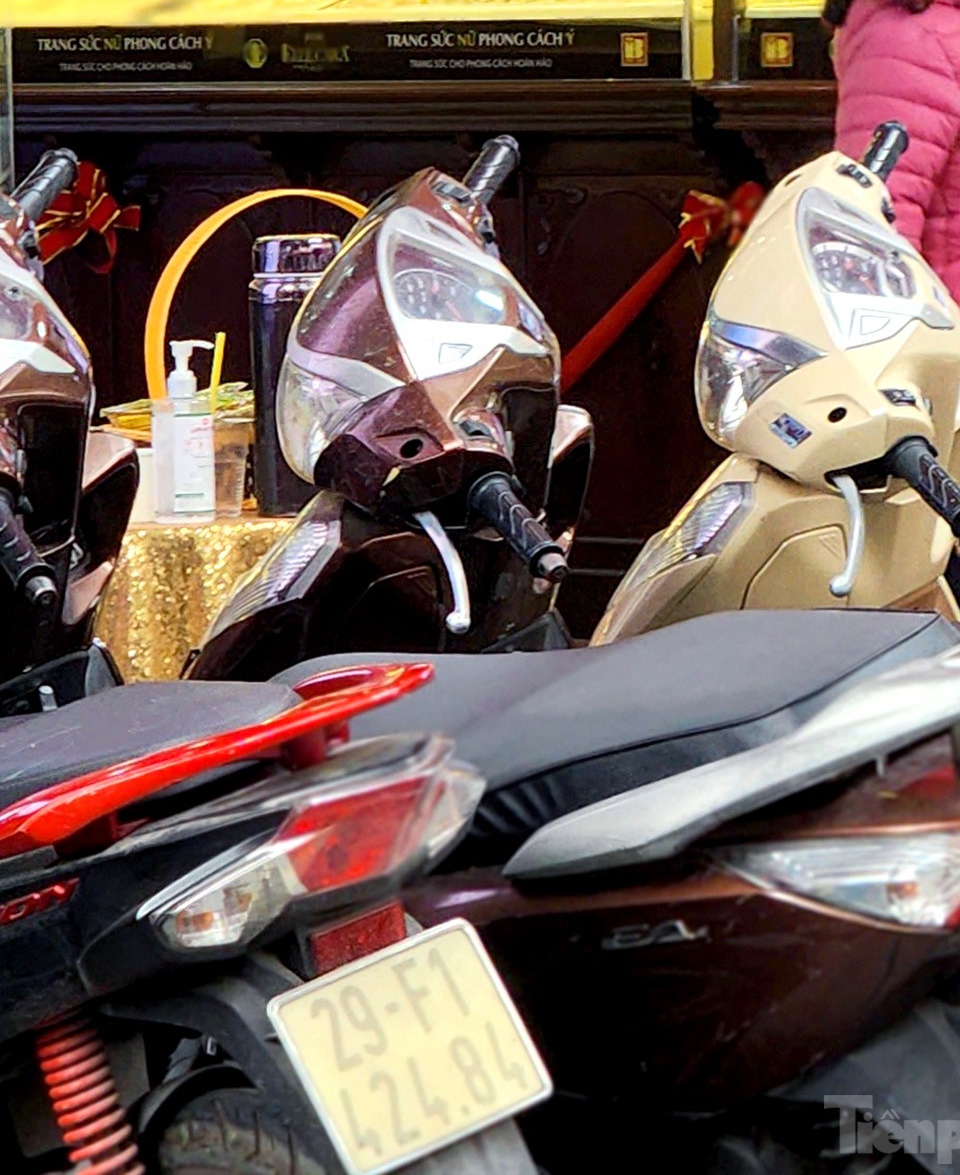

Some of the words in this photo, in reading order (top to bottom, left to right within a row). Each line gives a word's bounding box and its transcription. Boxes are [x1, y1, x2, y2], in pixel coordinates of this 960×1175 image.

[38, 38, 77, 51] TRANG
[124, 37, 167, 51] PHONG
[386, 33, 428, 47] TRANG
[478, 33, 526, 47] PHONG
[527, 28, 563, 47] CÁCH
[310, 947, 470, 1073] 29-F1
[339, 1021, 528, 1156] 424.84
